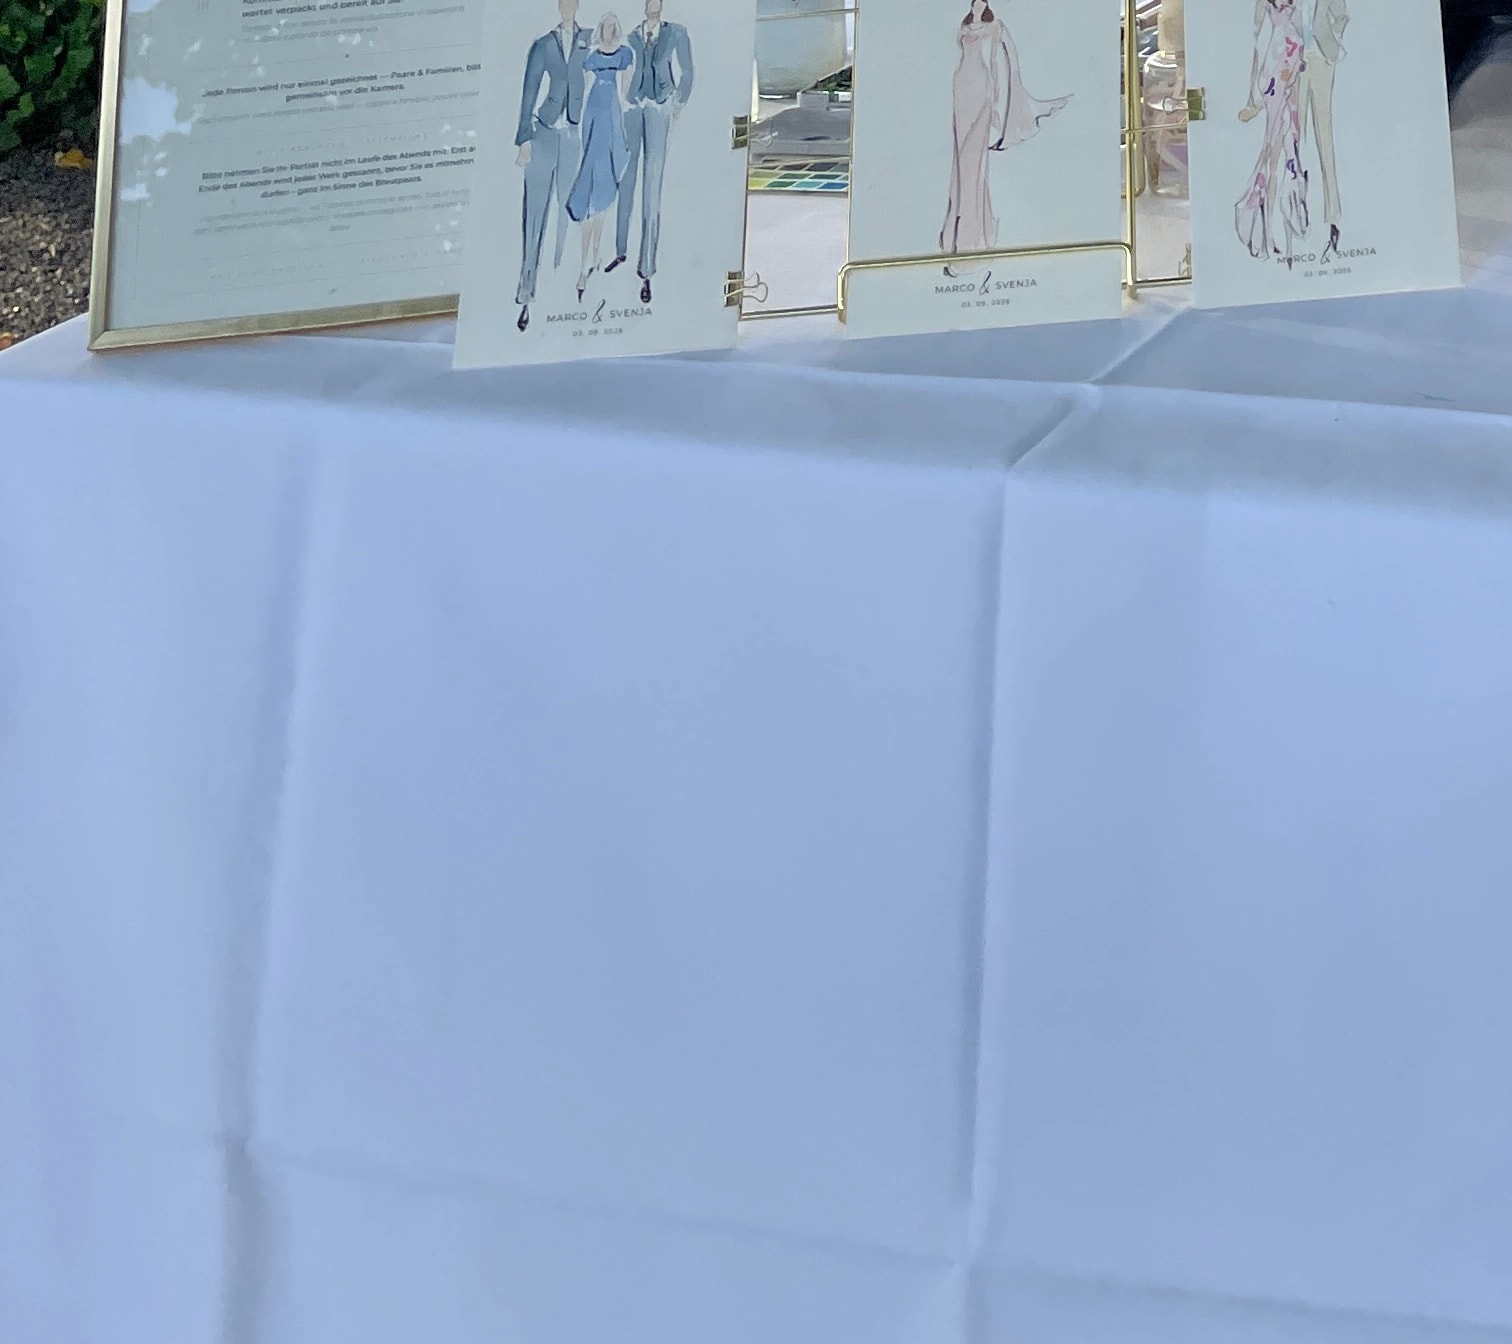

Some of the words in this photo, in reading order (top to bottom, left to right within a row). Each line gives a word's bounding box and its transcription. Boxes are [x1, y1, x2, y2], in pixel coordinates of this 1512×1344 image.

[241, 8, 272, 17] wartet
[275, 4, 316, 14] verpackt
[318, 1, 339, 11] und
[339, 0, 368, 8] bereit
[225, 86, 257, 95] Person
[329, 74, 377, 86] gezeichnet
[389, 70, 415, 79] Paare
[416, 68, 423, 76] &
[285, 90, 337, 102] gemeinsam
[338, 88, 352, 96] vor
[353, 86, 368, 94] die
[223, 168, 260, 177] nehmen
[261, 165, 275, 174] Sie
[321, 159, 342, 167] nicht
[356, 154, 381, 164] Laufe
[381, 153, 397, 161] des
[450, 146, 467, 154] Erst
[198, 184, 221, 192] Ende
[221, 182, 237, 190] des
[317, 171, 340, 180] Werk
[384, 165, 408, 173] bevor
[409, 162, 423, 170] Sie
[296, 186, 318, 196] ganz
[318, 184, 331, 192] im
[332, 182, 356, 191] Sinne
[357, 180, 373, 188] des
[1320, 240, 1331, 265] &
[1336, 247, 1377, 259] SVENJA
[934, 283, 976, 294] MARCO
[978, 270, 992, 296] &
[995, 278, 1038, 290] SVENJA
[546, 312, 588, 322] MARCO
[591, 299, 606, 324] &
[609, 307, 653, 319] SVENJA
